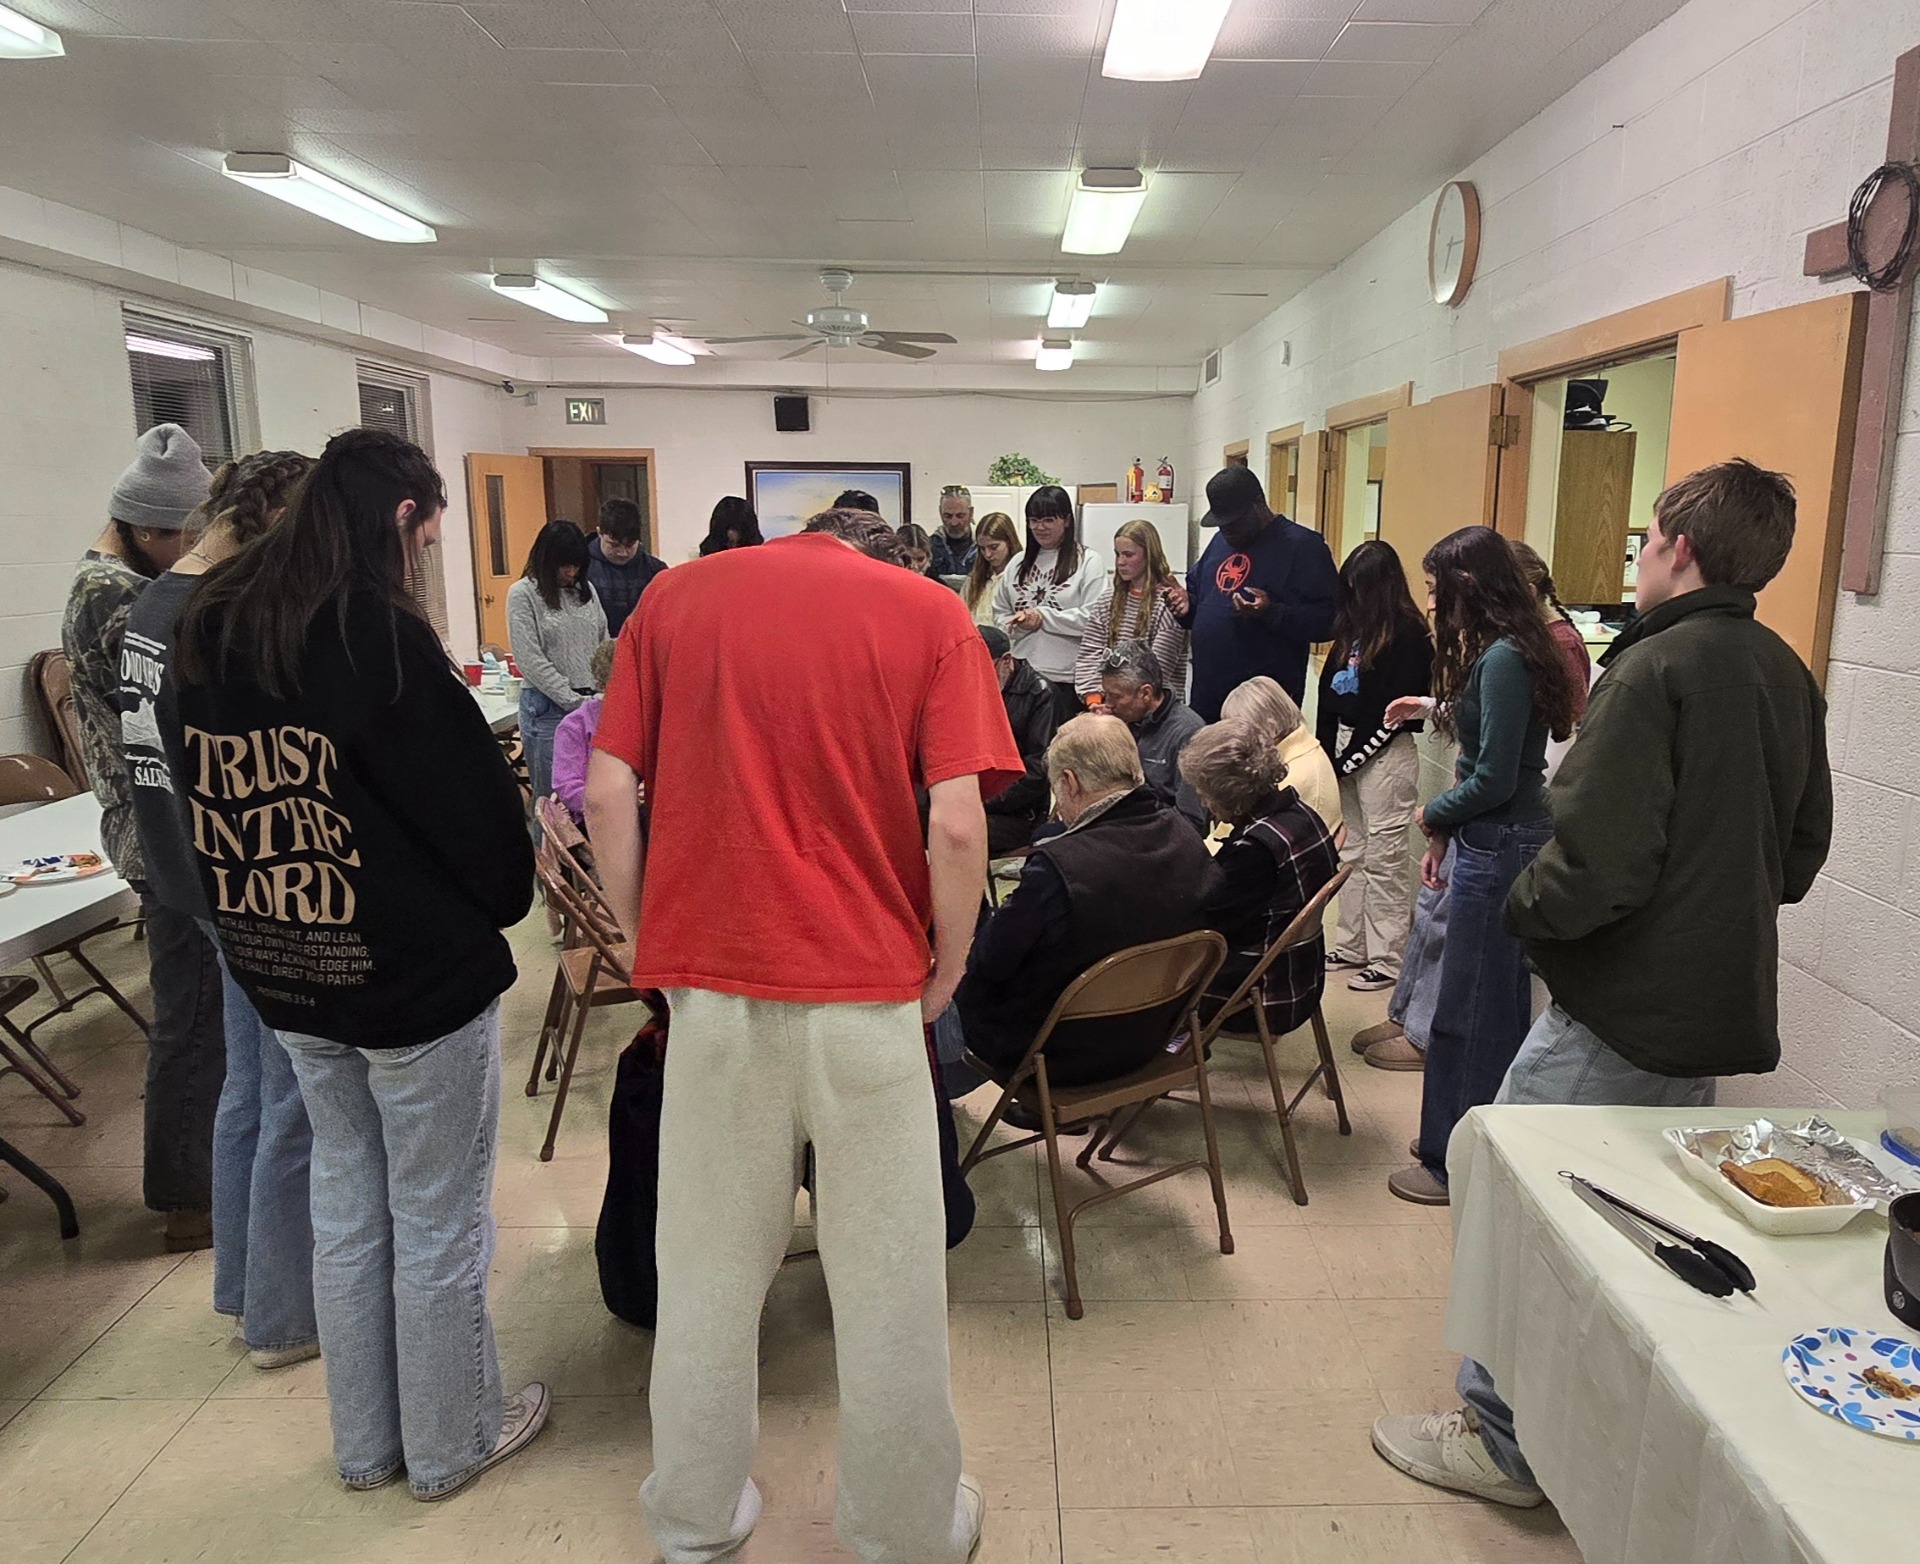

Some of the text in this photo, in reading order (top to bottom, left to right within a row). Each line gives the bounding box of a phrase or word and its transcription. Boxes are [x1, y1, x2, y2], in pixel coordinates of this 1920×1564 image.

[184, 725, 337, 799] TRUST
[1342, 722, 1399, 774] TITCH
[188, 796, 361, 867] IN THE
[211, 861, 355, 924] LORD
[238, 920, 254, 932] ALL
[305, 931, 330, 943] AND
[333, 932, 361, 943] LEAN
[264, 936, 285, 949] OWN
[254, 948, 280, 962] WAYS
[271, 965, 304, 979] DIRECT
